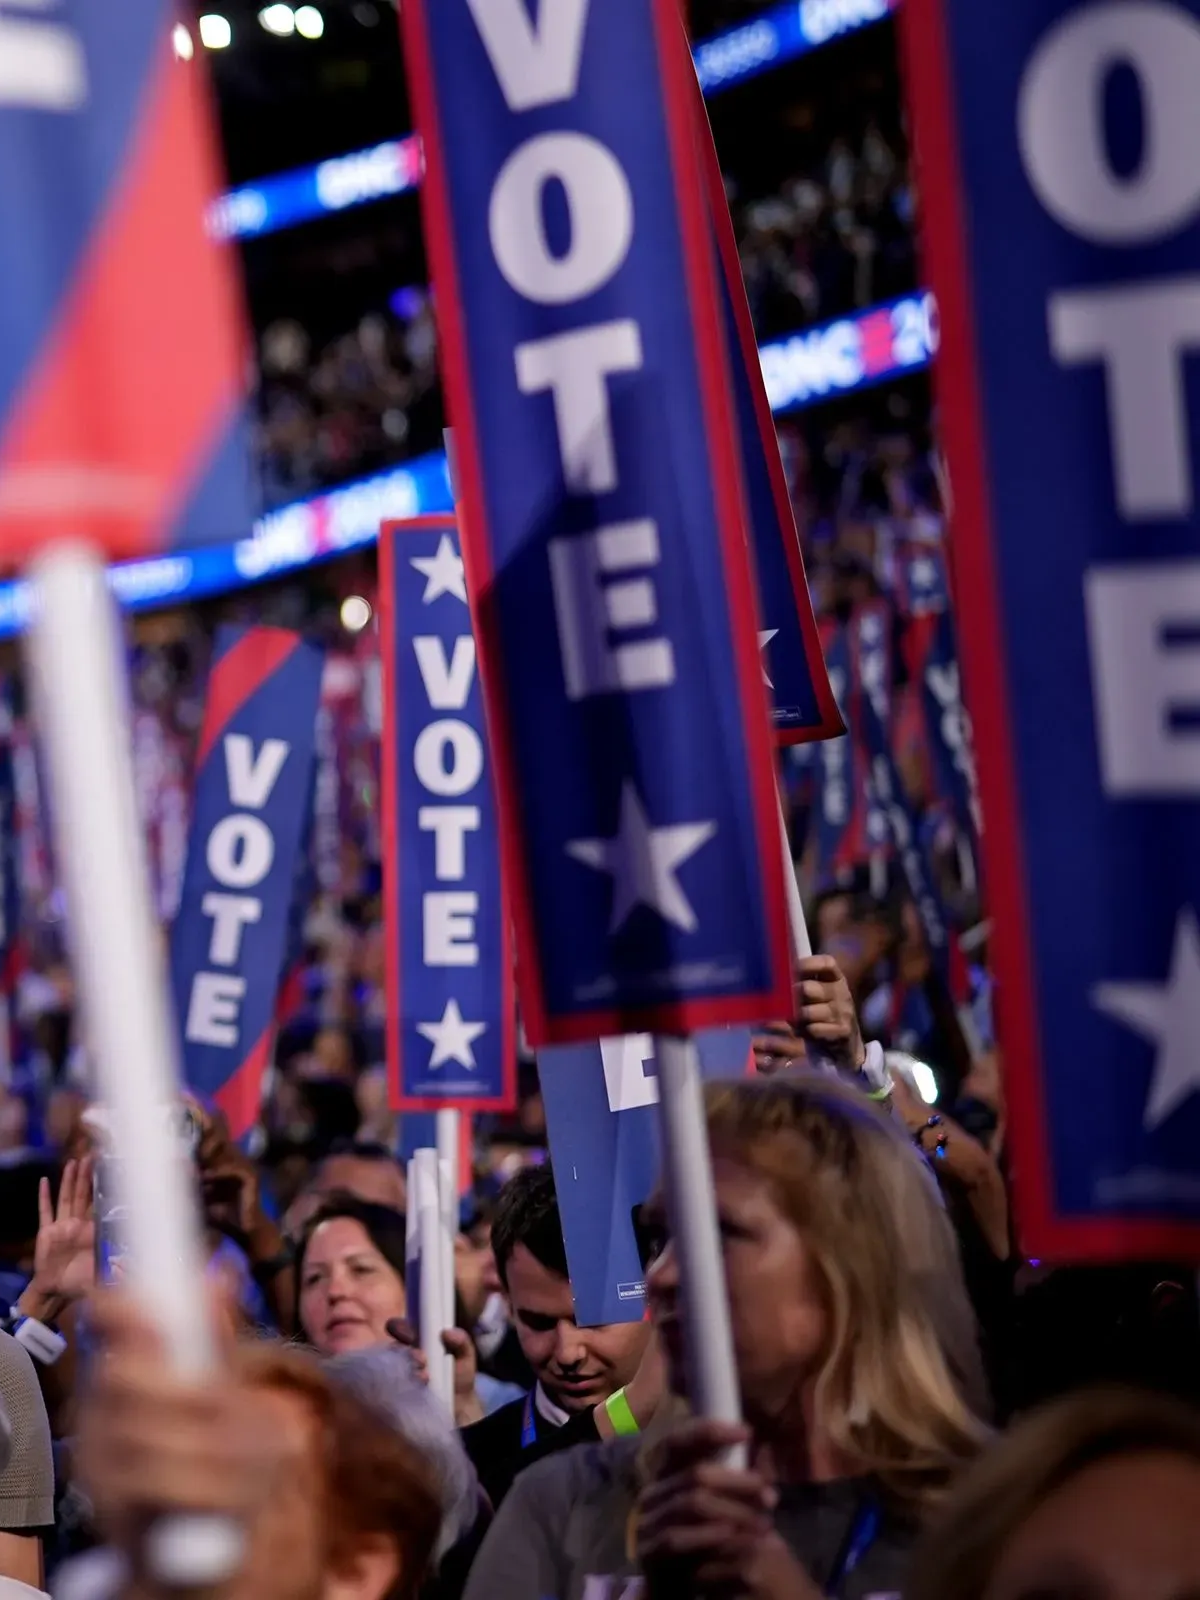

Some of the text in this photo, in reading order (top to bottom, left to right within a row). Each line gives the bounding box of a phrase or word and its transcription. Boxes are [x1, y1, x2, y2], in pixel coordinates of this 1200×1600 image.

[465, 0, 675, 700] VOTE
[185, 733, 291, 1049] VOTE
[412, 636, 483, 968] VOTE
